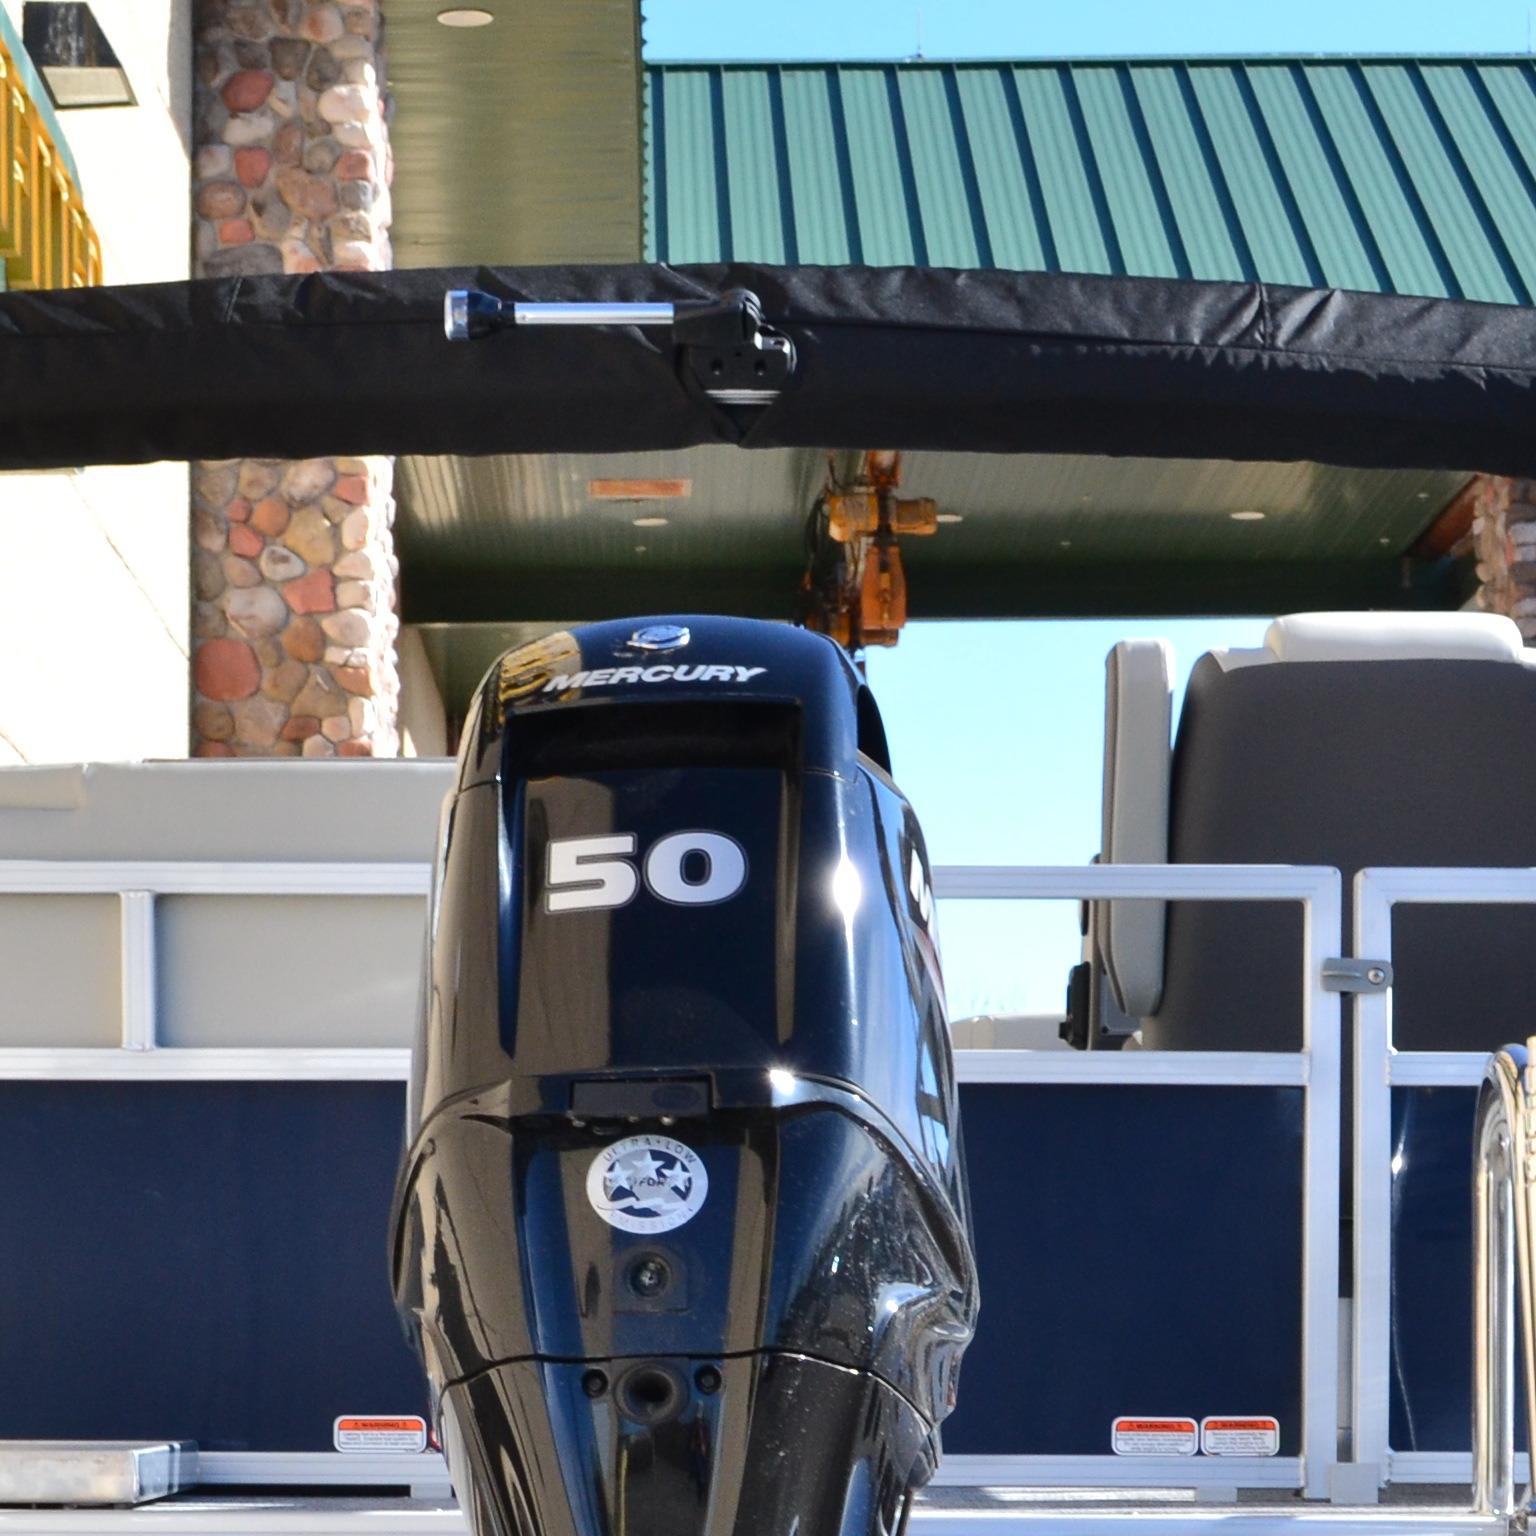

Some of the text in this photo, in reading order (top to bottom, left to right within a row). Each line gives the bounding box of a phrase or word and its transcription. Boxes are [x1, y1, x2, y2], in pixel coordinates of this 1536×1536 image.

[543, 664, 767, 692] MERCURY
[546, 829, 749, 914] 50
[664, 1140, 697, 1164] LOW
